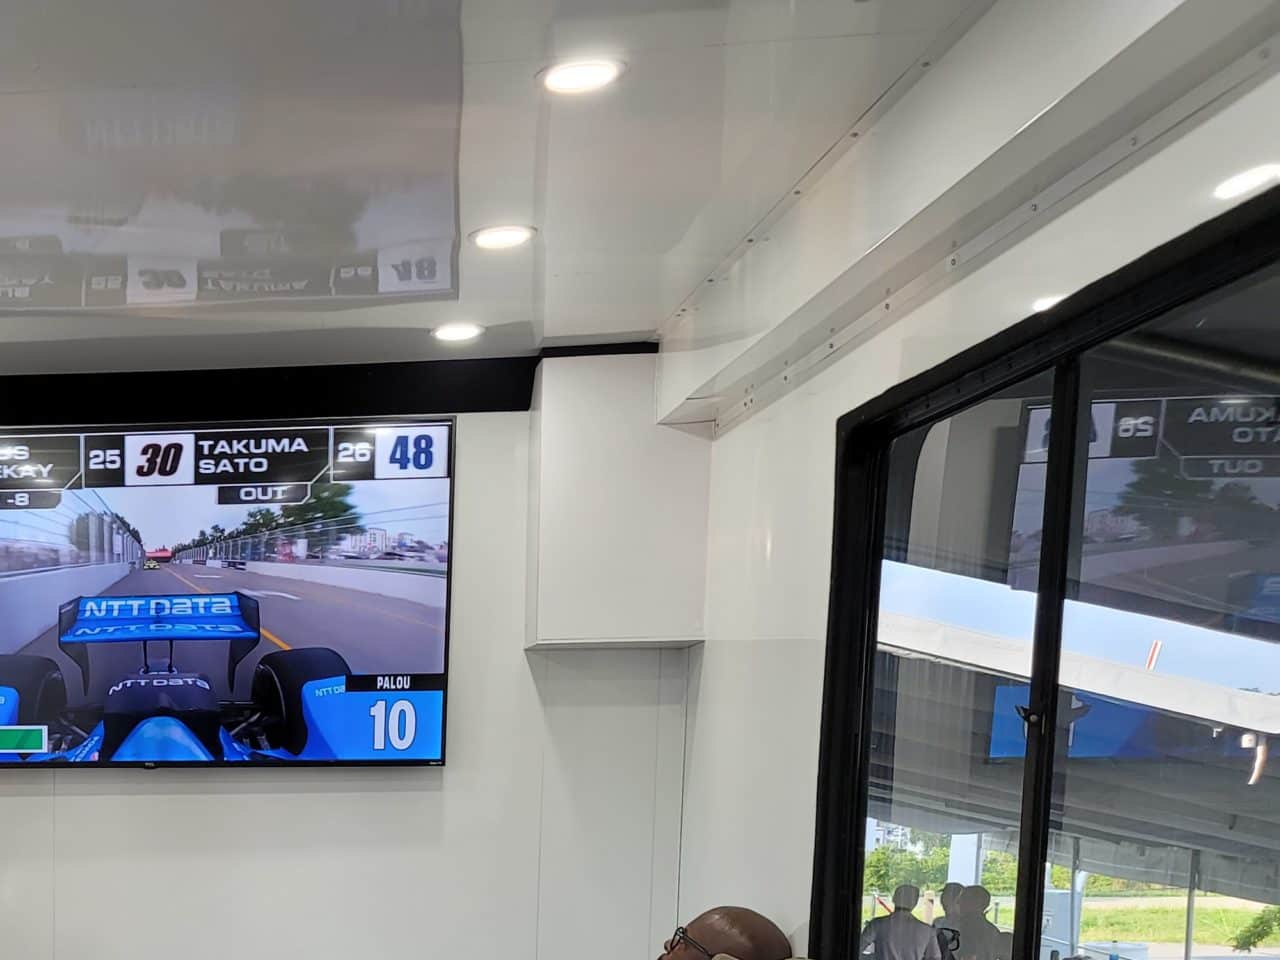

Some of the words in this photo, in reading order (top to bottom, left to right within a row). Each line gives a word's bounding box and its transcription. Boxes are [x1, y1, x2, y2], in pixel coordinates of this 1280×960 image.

[198, 438, 308, 455] TAKUMA
[337, 442, 370, 462] 26
[389, 434, 433, 470] 48
[88, 449, 121, 470] 25
[136, 443, 183, 477] 30
[199, 458, 268, 474] SATO
[6, 493, 30, 506] -8
[239, 486, 289, 501] OUT
[84, 600, 144, 617] NTT
[74, 624, 144, 636] NTT
[108, 679, 150, 695] NTT
[377, 675, 411, 689] PALOU
[315, 687, 334, 697] NTT
[370, 699, 417, 750] 10
